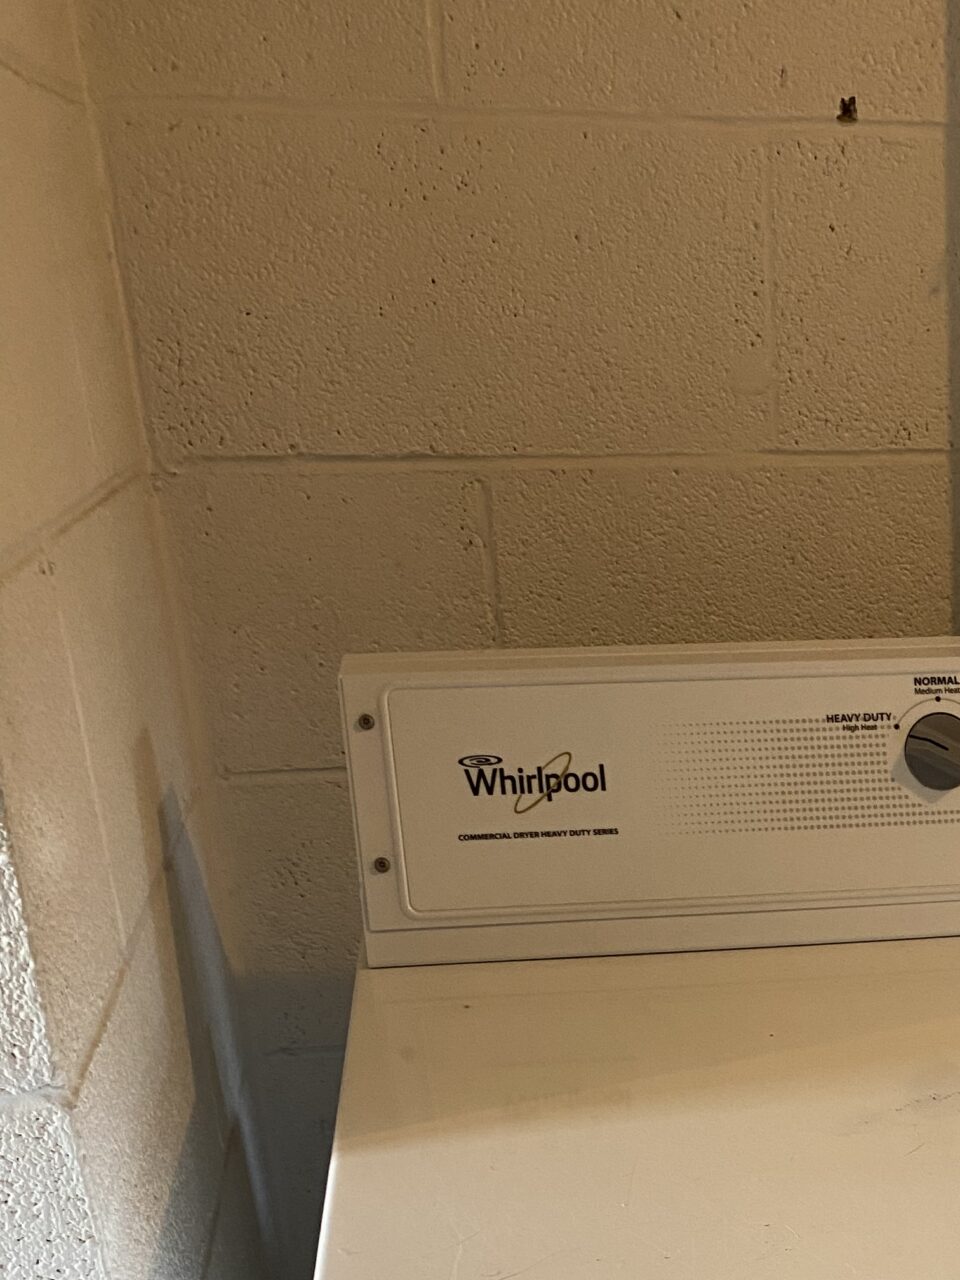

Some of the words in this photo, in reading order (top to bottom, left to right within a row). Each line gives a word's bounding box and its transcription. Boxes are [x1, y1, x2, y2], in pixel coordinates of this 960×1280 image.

[914, 676, 960, 686] NORMAL
[914, 687, 943, 695] Medium
[944, 686, 960, 694] Heat
[826, 714, 861, 723] HEAVY
[863, 712, 892, 722] DUTY
[842, 723, 859, 732] High
[860, 723, 878, 731] Heat
[464, 764, 606, 802] Whirlpool
[458, 832, 512, 841] COMMERCIAL
[513, 831, 539, 839] DRYER
[540, 830, 568, 838] HEAVY
[569, 829, 591, 837] DUTY
[592, 828, 619, 836] SERIES
